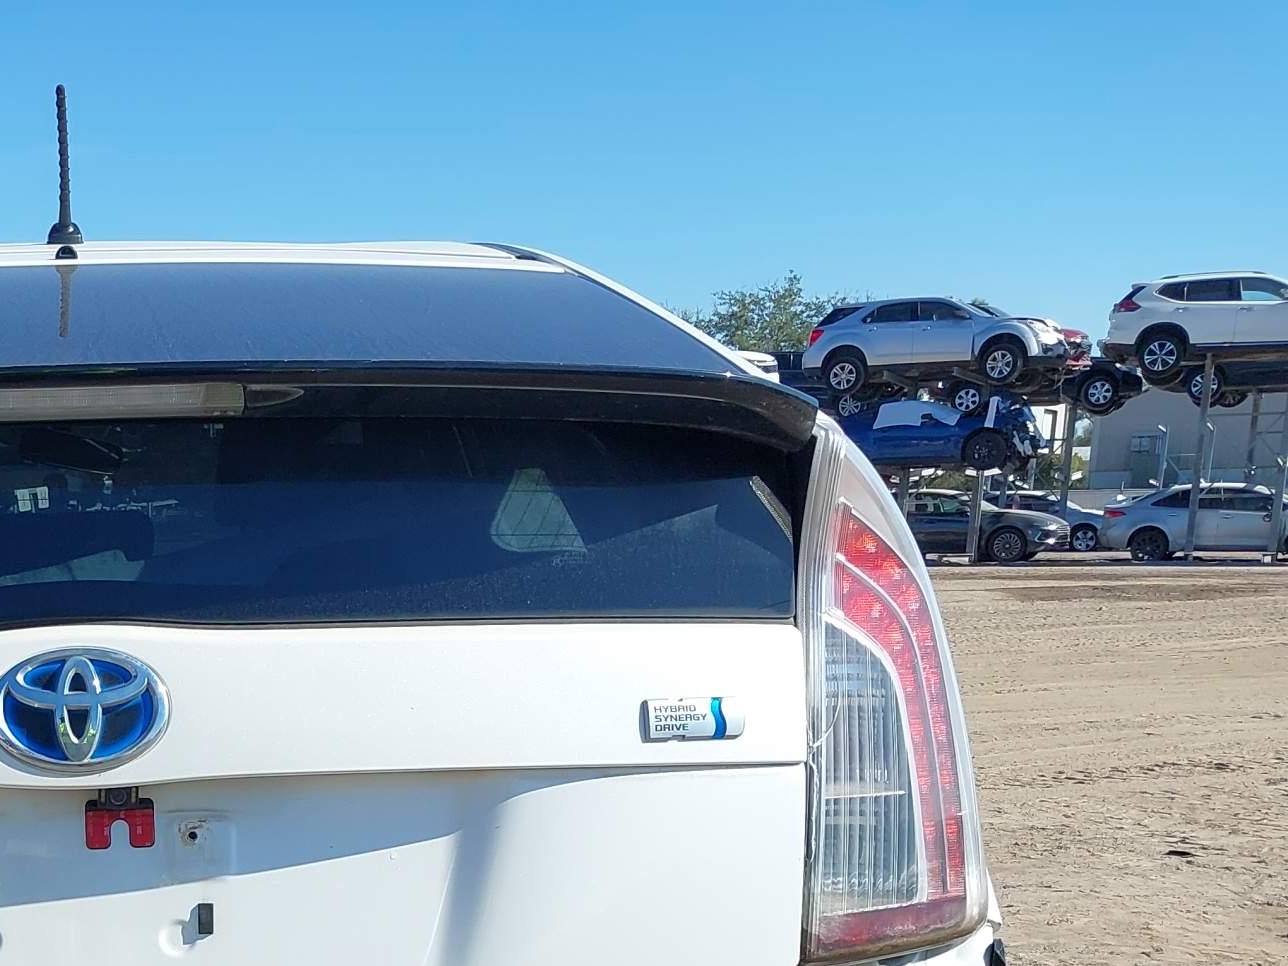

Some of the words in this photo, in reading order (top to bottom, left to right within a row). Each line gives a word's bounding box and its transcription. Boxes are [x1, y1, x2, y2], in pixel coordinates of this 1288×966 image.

[653, 704, 697, 713] HYBRID
[654, 713, 708, 722] SYNERGY
[654, 723, 689, 732] DRIVE
